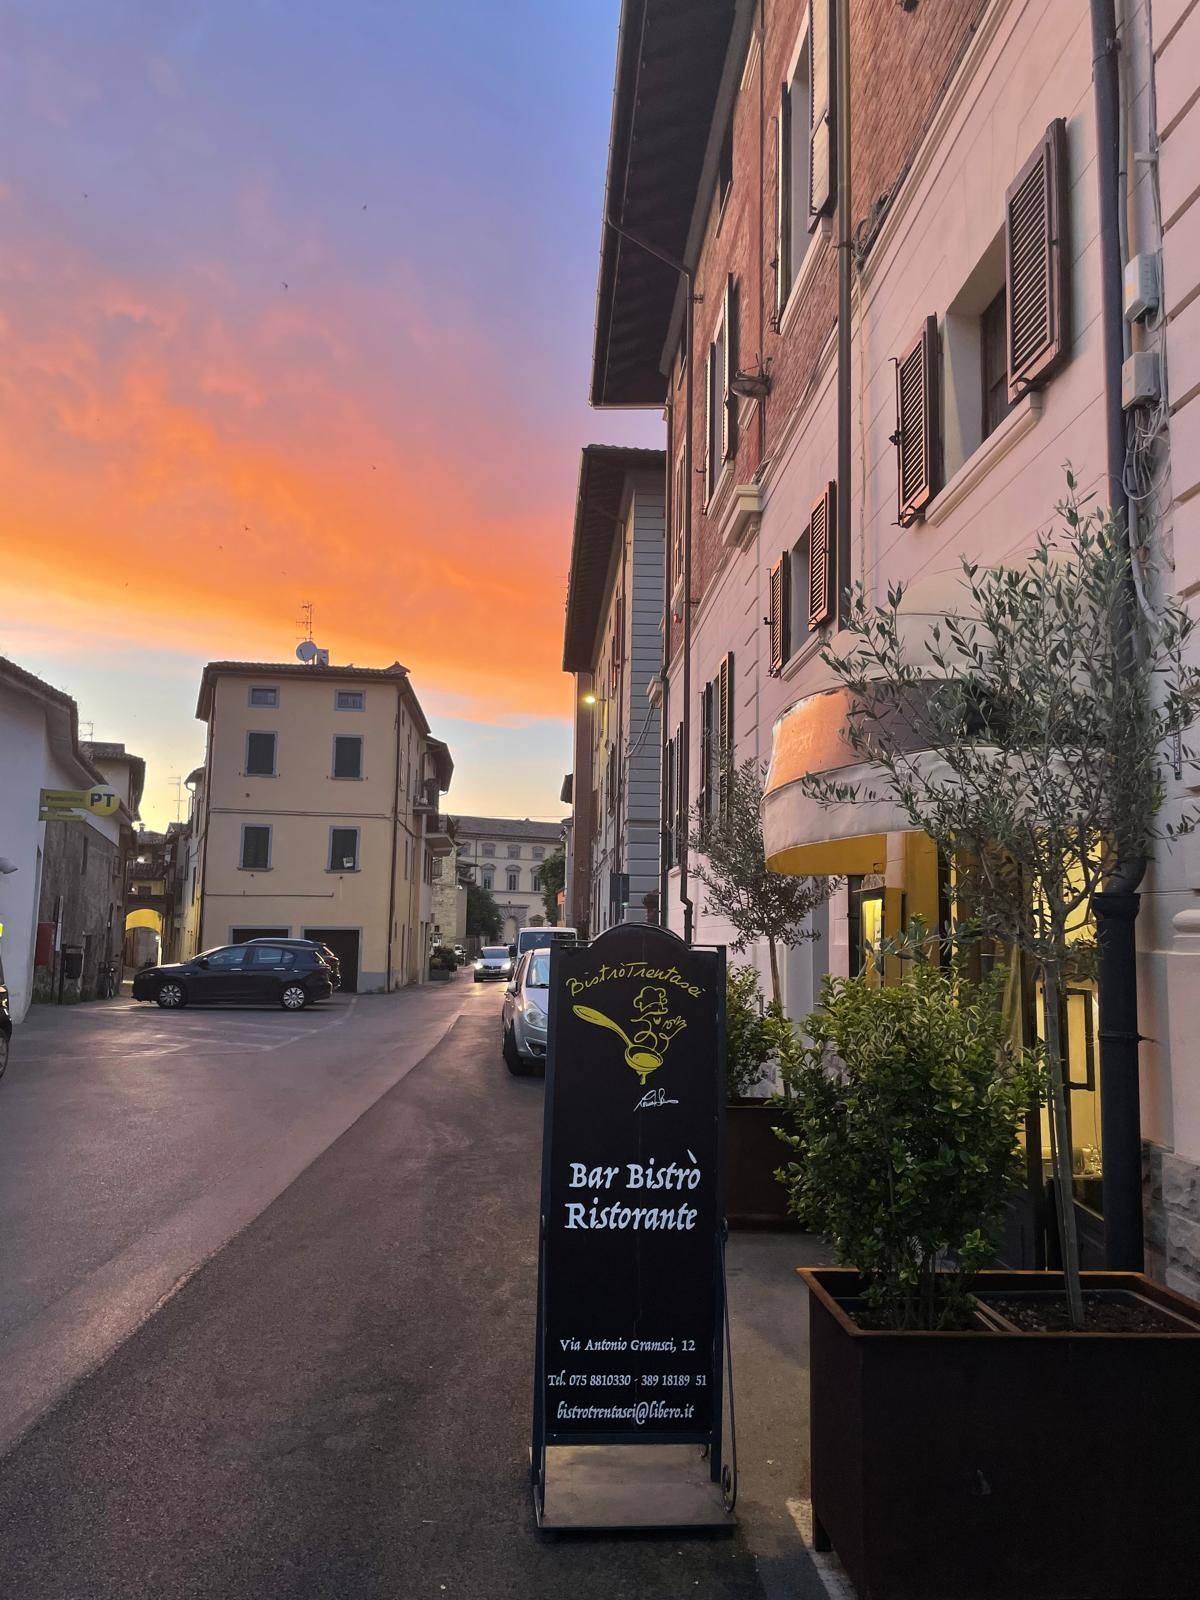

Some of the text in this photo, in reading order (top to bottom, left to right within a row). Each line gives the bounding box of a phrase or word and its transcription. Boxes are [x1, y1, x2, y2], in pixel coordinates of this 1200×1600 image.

[90, 793, 115, 808] PT
[568, 1149, 701, 1190] Bar Bistrò
[563, 1196, 698, 1231] Ristorante
[559, 1336, 696, 1354] Via Antonio Gramsci, 12
[547, 1369, 567, 1386] Tel.
[569, 1374, 587, 1386] 075
[589, 1374, 631, 1386] 8810330
[641, 1374, 659, 1387] 389
[662, 1374, 691, 1387] 18189
[695, 1374, 707, 1386] 51
[556, 1400, 695, 1425] bistrotrentasei@libero.it
